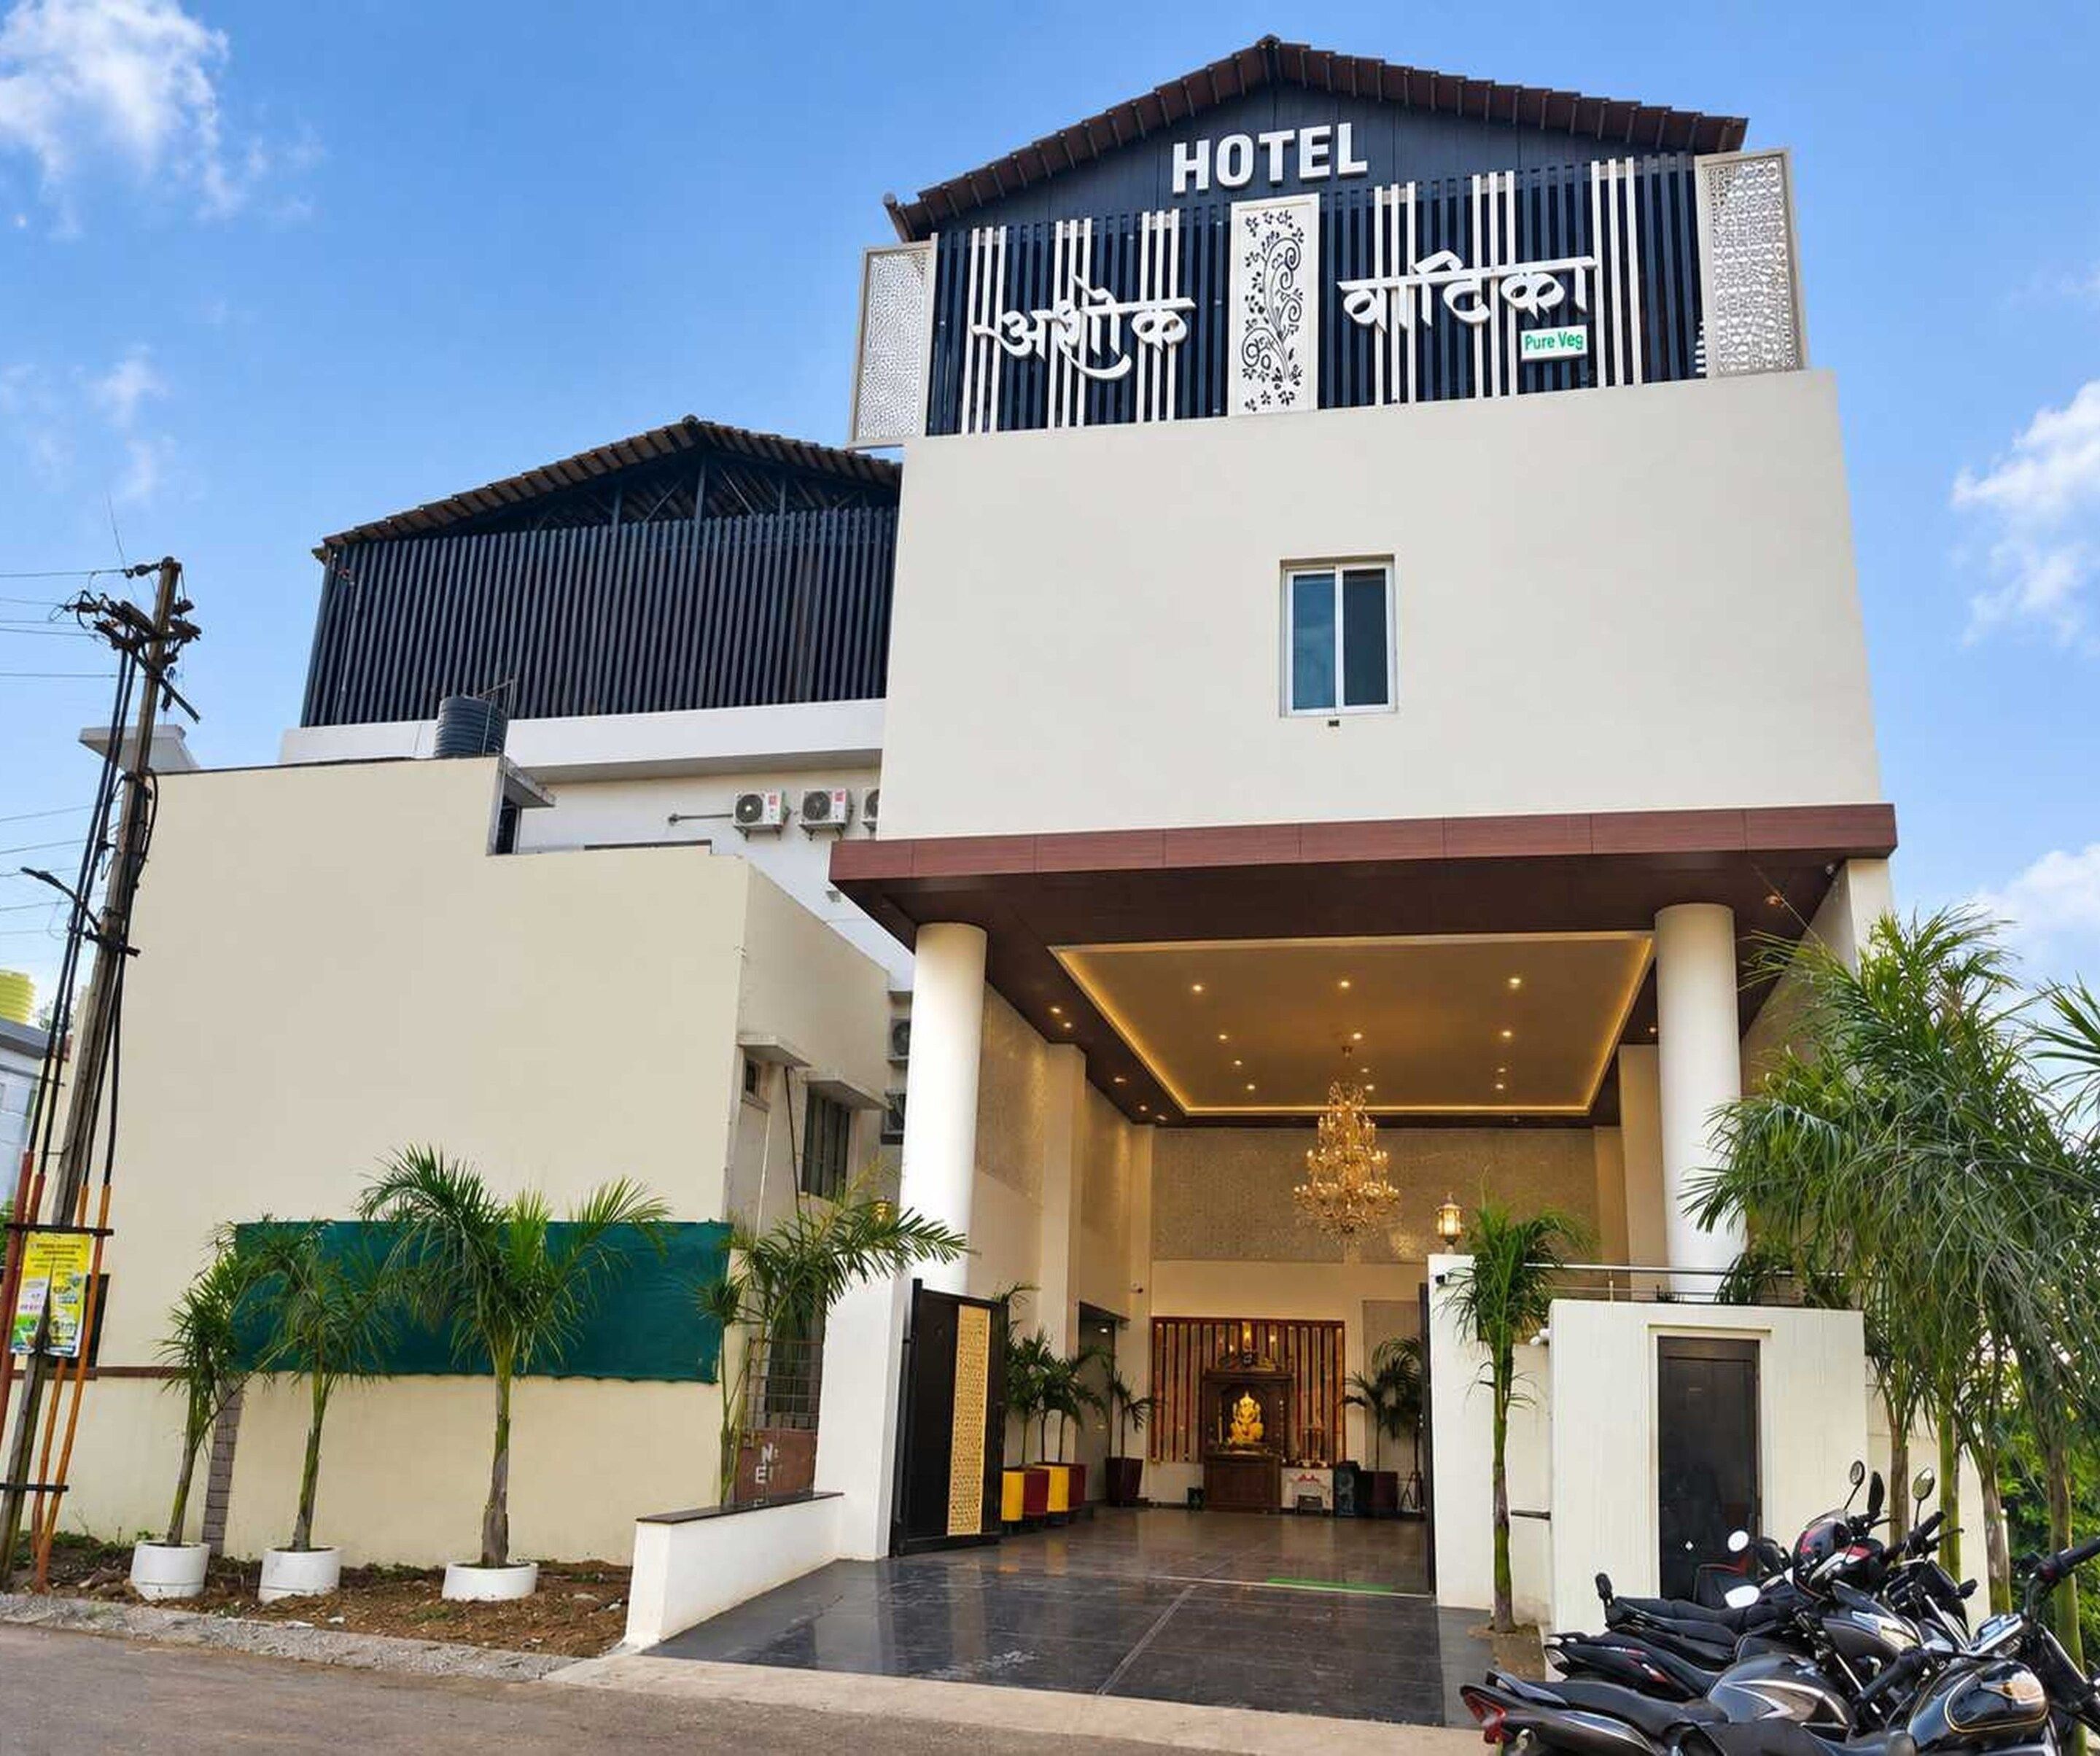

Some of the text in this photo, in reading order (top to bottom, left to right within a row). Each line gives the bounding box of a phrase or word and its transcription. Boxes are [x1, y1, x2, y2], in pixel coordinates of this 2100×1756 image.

[1172, 123, 1367, 193] HOTEL
[970, 250, 1599, 379] अशोक वाटिका
[1525, 331, 1584, 351] Pure Veg
